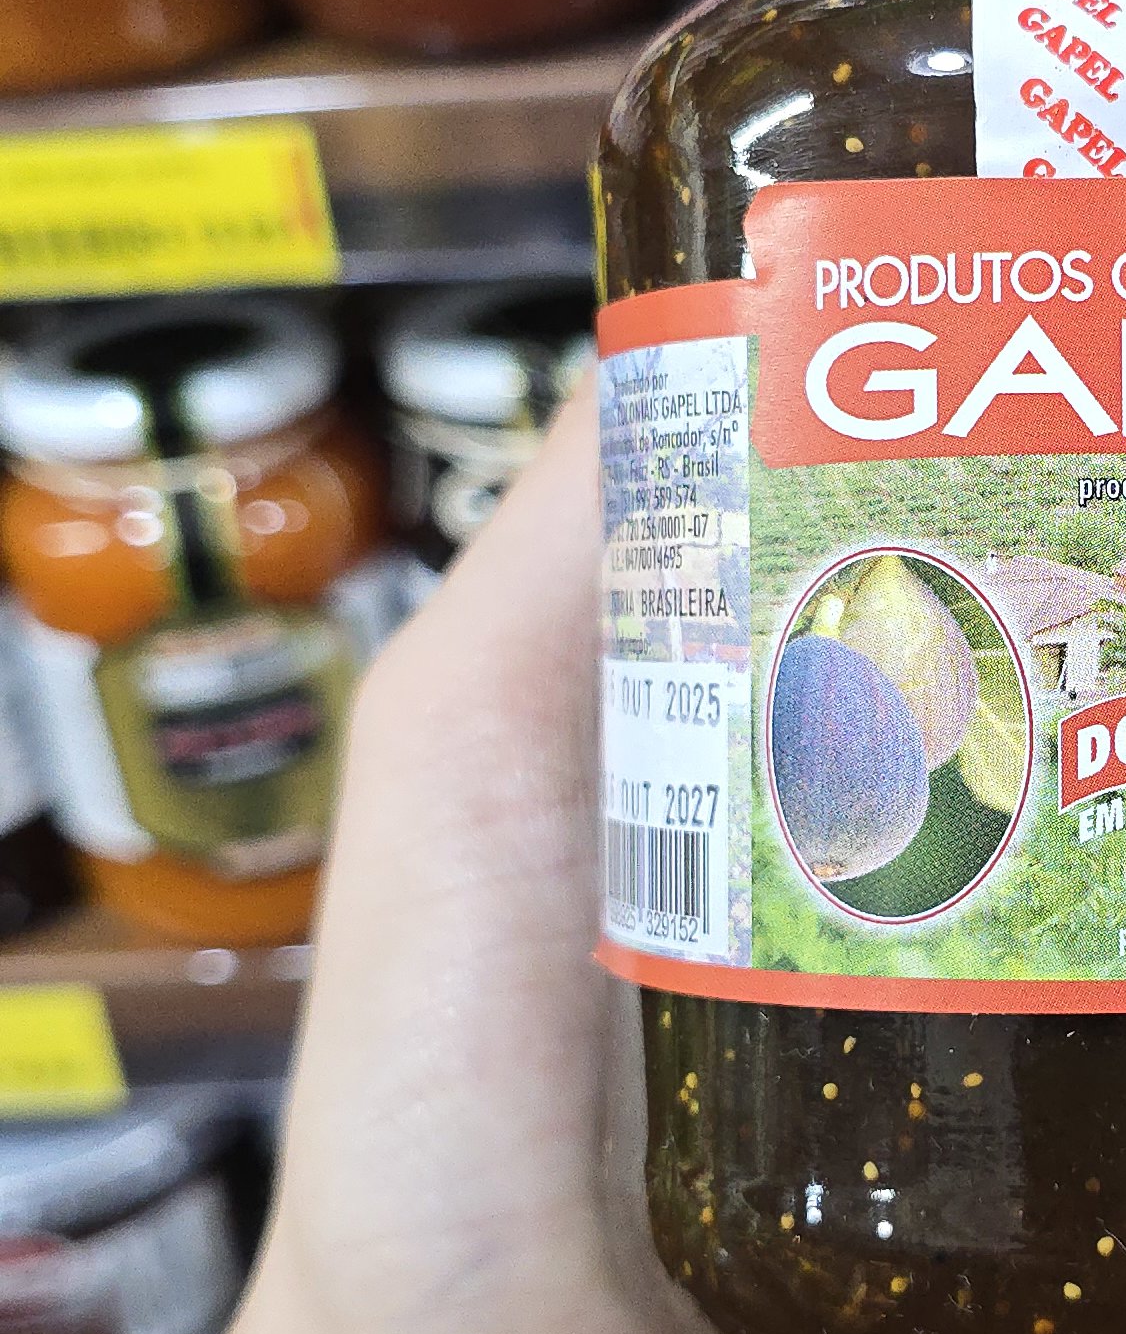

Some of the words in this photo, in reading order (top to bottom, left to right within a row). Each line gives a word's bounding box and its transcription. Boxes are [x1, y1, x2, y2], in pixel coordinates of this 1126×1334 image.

[1017, 7, 1125, 103] GAPEL
[815, 250, 1094, 310] PRODUTOS
[661, 392, 701, 420] GAPEL
[682, 450, 719, 478] Brasil
[641, 587, 729, 617] BRASILEIRA
[621, 675, 653, 717] OUT
[666, 680, 721, 728] 2025
[620, 778, 651, 823] OUT
[665, 782, 720, 829] 2027
[1078, 796, 1125, 843] EM
[646, 908, 699, 943] 329152
